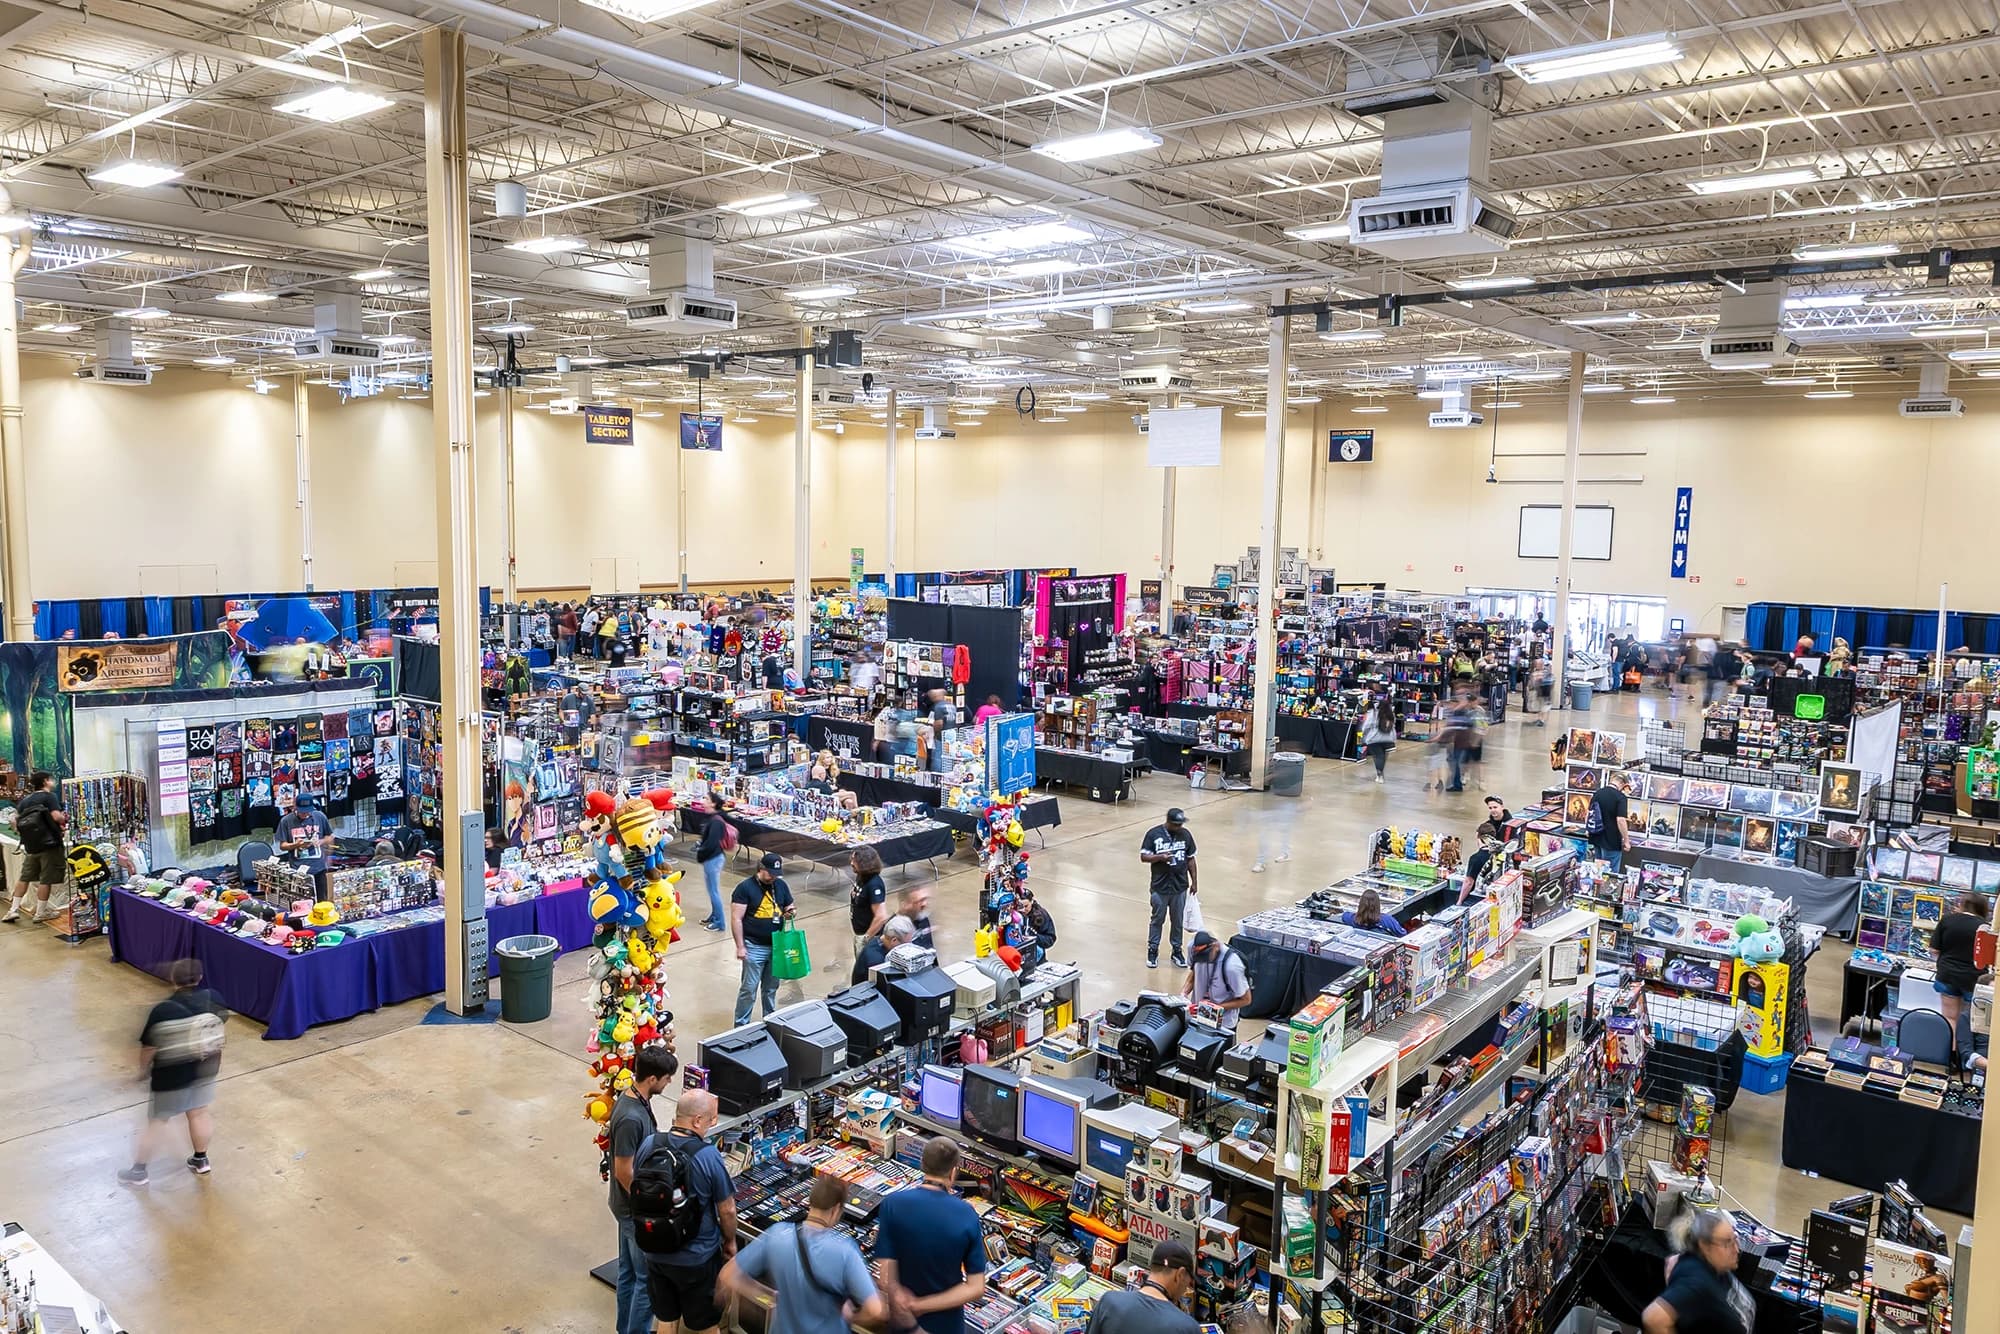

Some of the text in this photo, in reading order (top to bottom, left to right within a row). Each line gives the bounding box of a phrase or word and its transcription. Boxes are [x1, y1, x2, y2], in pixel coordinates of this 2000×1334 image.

[588, 414, 631, 425] TABLETOP
[592, 427, 629, 438] SECTION
[1674, 495, 1688, 545] ATM
[103, 655, 161, 666] HANDMADE
[101, 664, 172, 679] ARTISAN DICE
[1303, 1137, 1311, 1159] DOUBLES
[1129, 1214, 1168, 1241] ATARI
[1884, 1305, 1920, 1322] SPEEDBALL
